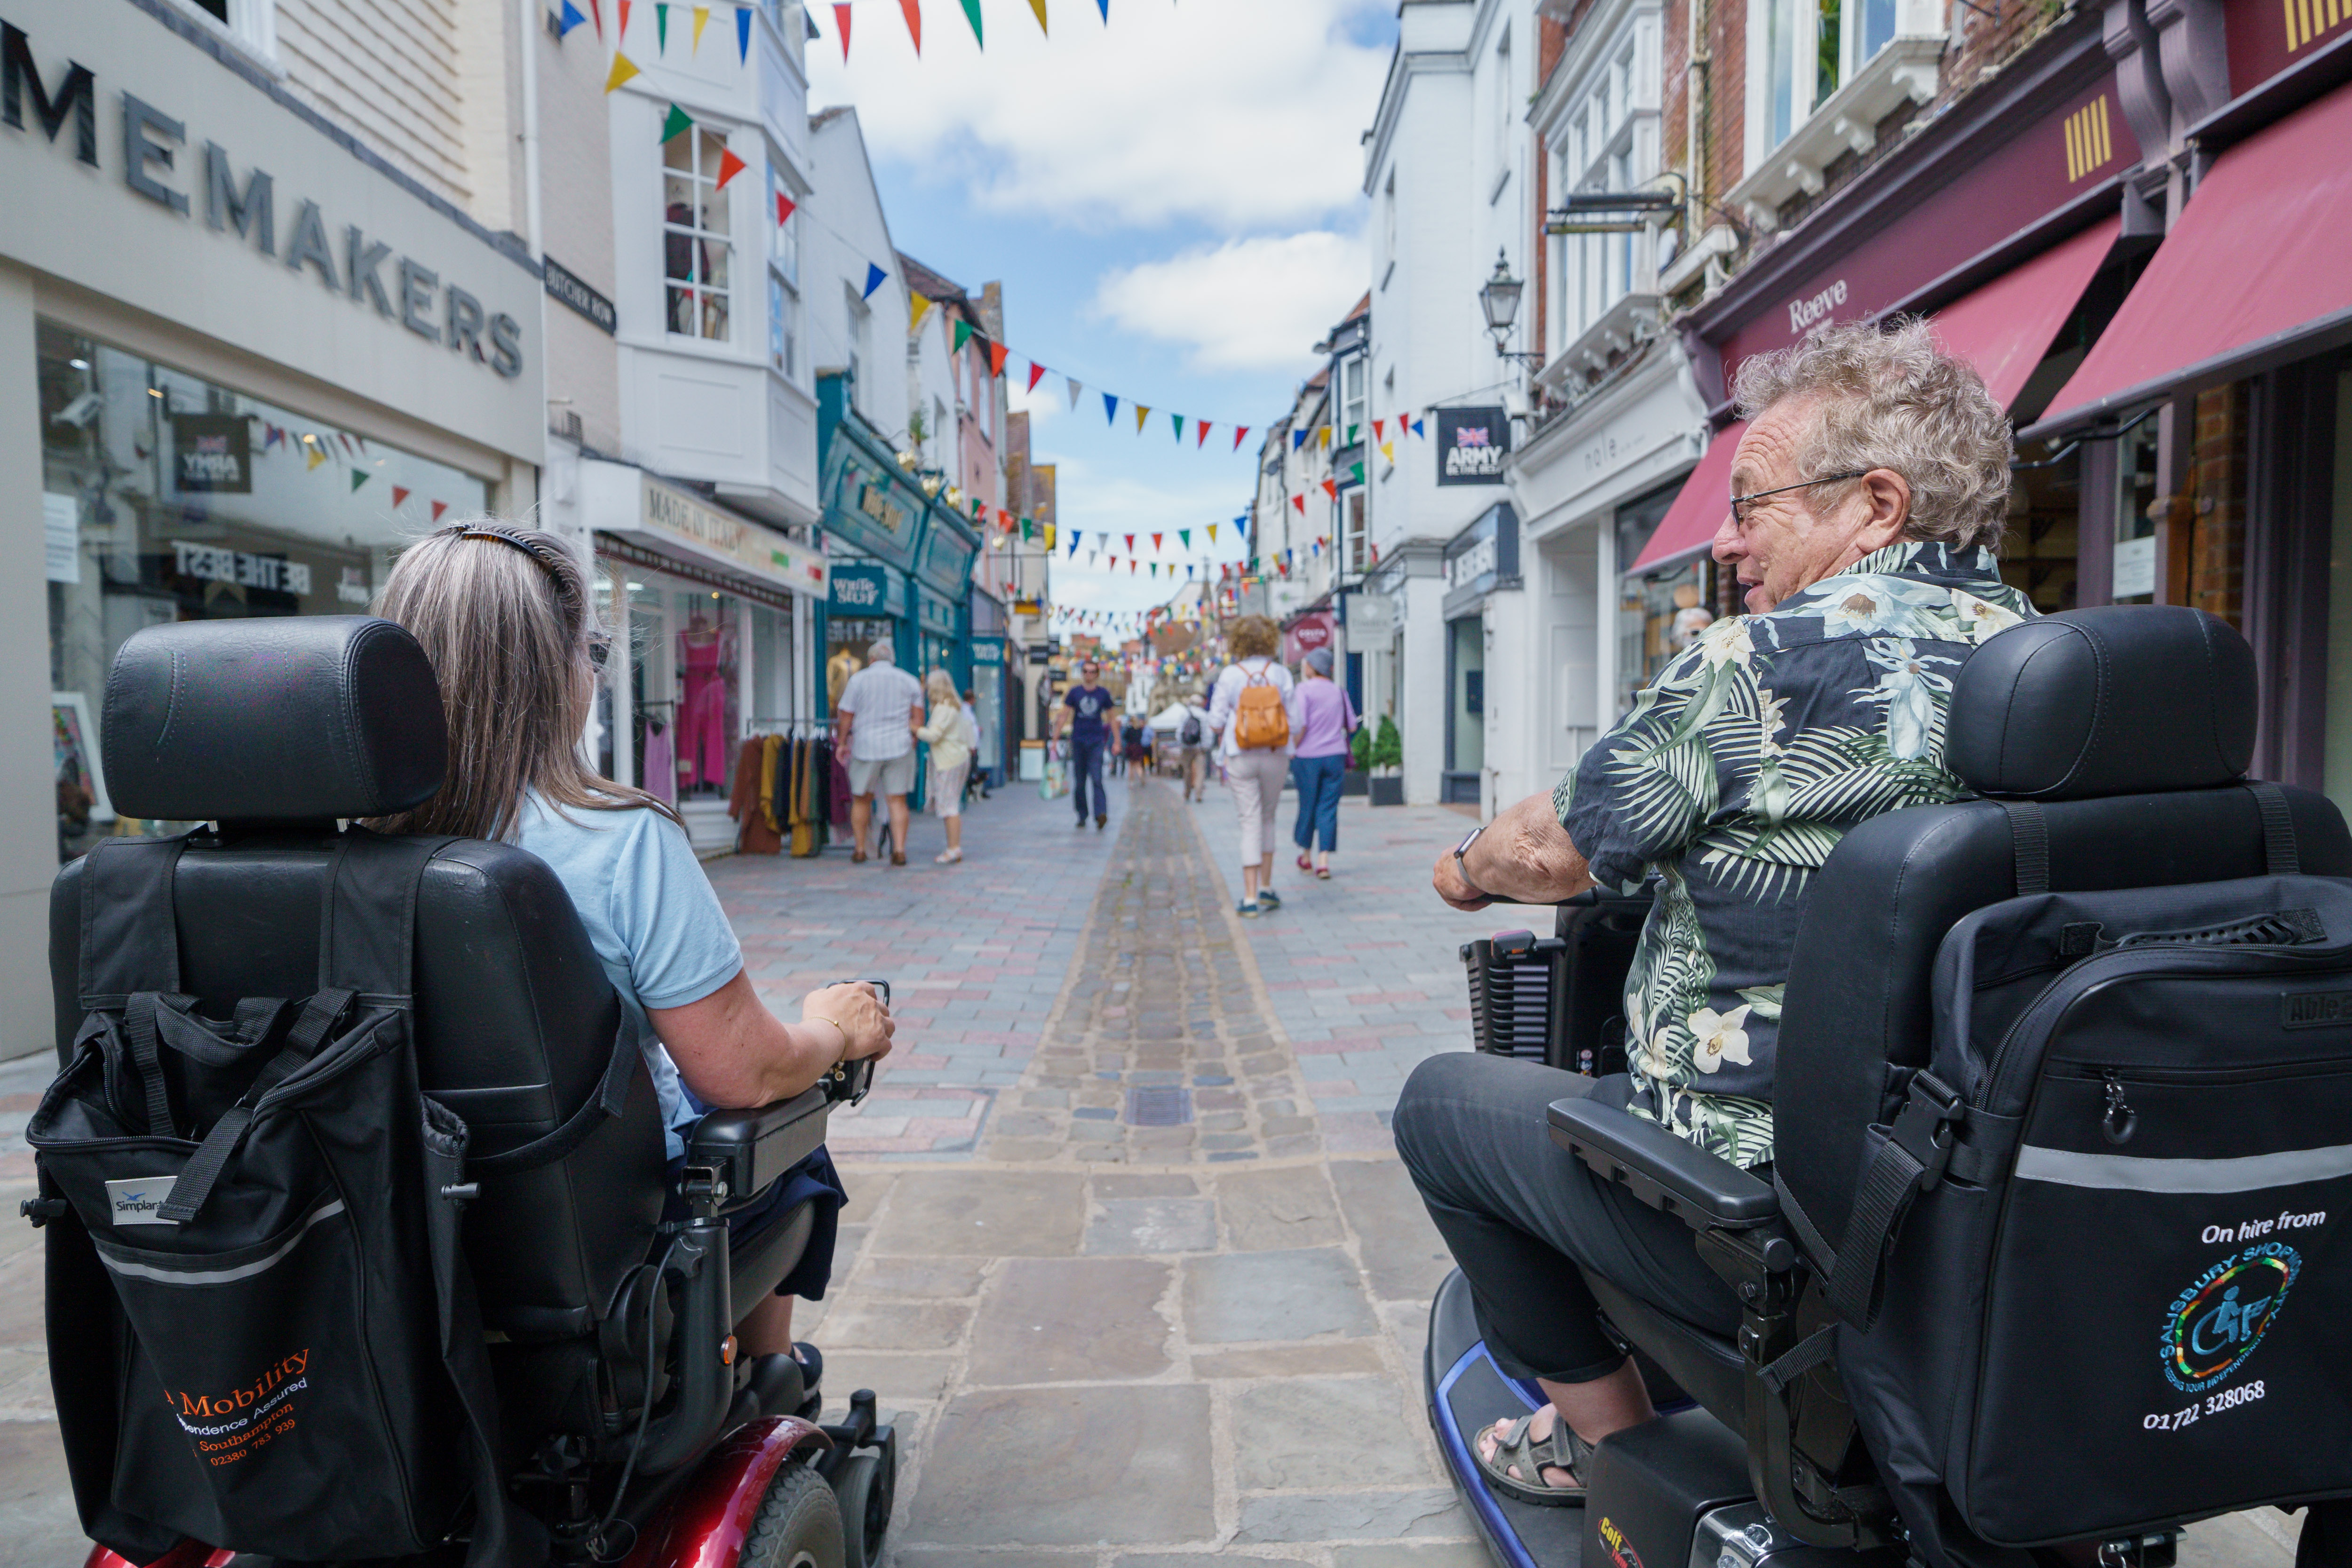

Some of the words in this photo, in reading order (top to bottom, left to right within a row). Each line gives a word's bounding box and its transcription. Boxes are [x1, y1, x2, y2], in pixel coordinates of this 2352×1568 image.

[546, 265, 589, 313] BUTCHER
[591, 296, 612, 323] ROW
[1788, 279, 1847, 335] Reeve
[1446, 446, 1503, 466] ARMY
[650, 489, 689, 533] MADE
[116, 1200, 162, 1212] Simplan
[2201, 1225, 2234, 1243] On
[2238, 1219, 2274, 1242] hire
[2277, 1211, 2326, 1230] from
[2160, 1254, 2238, 1359] SALISBURY
[179, 1348, 309, 1417] Mobility
[254, 1377, 307, 1419] Assured
[2143, 1403, 2200, 1432] 01722
[2205, 1380, 2265, 1415] 328068
[199, 1403, 294, 1451] Southampton
[210, 1449, 247, 1466] 02380
[252, 1433, 271, 1449] 783
[275, 1419, 295, 1434] 939
[1601, 1517, 1622, 1552] Colt
